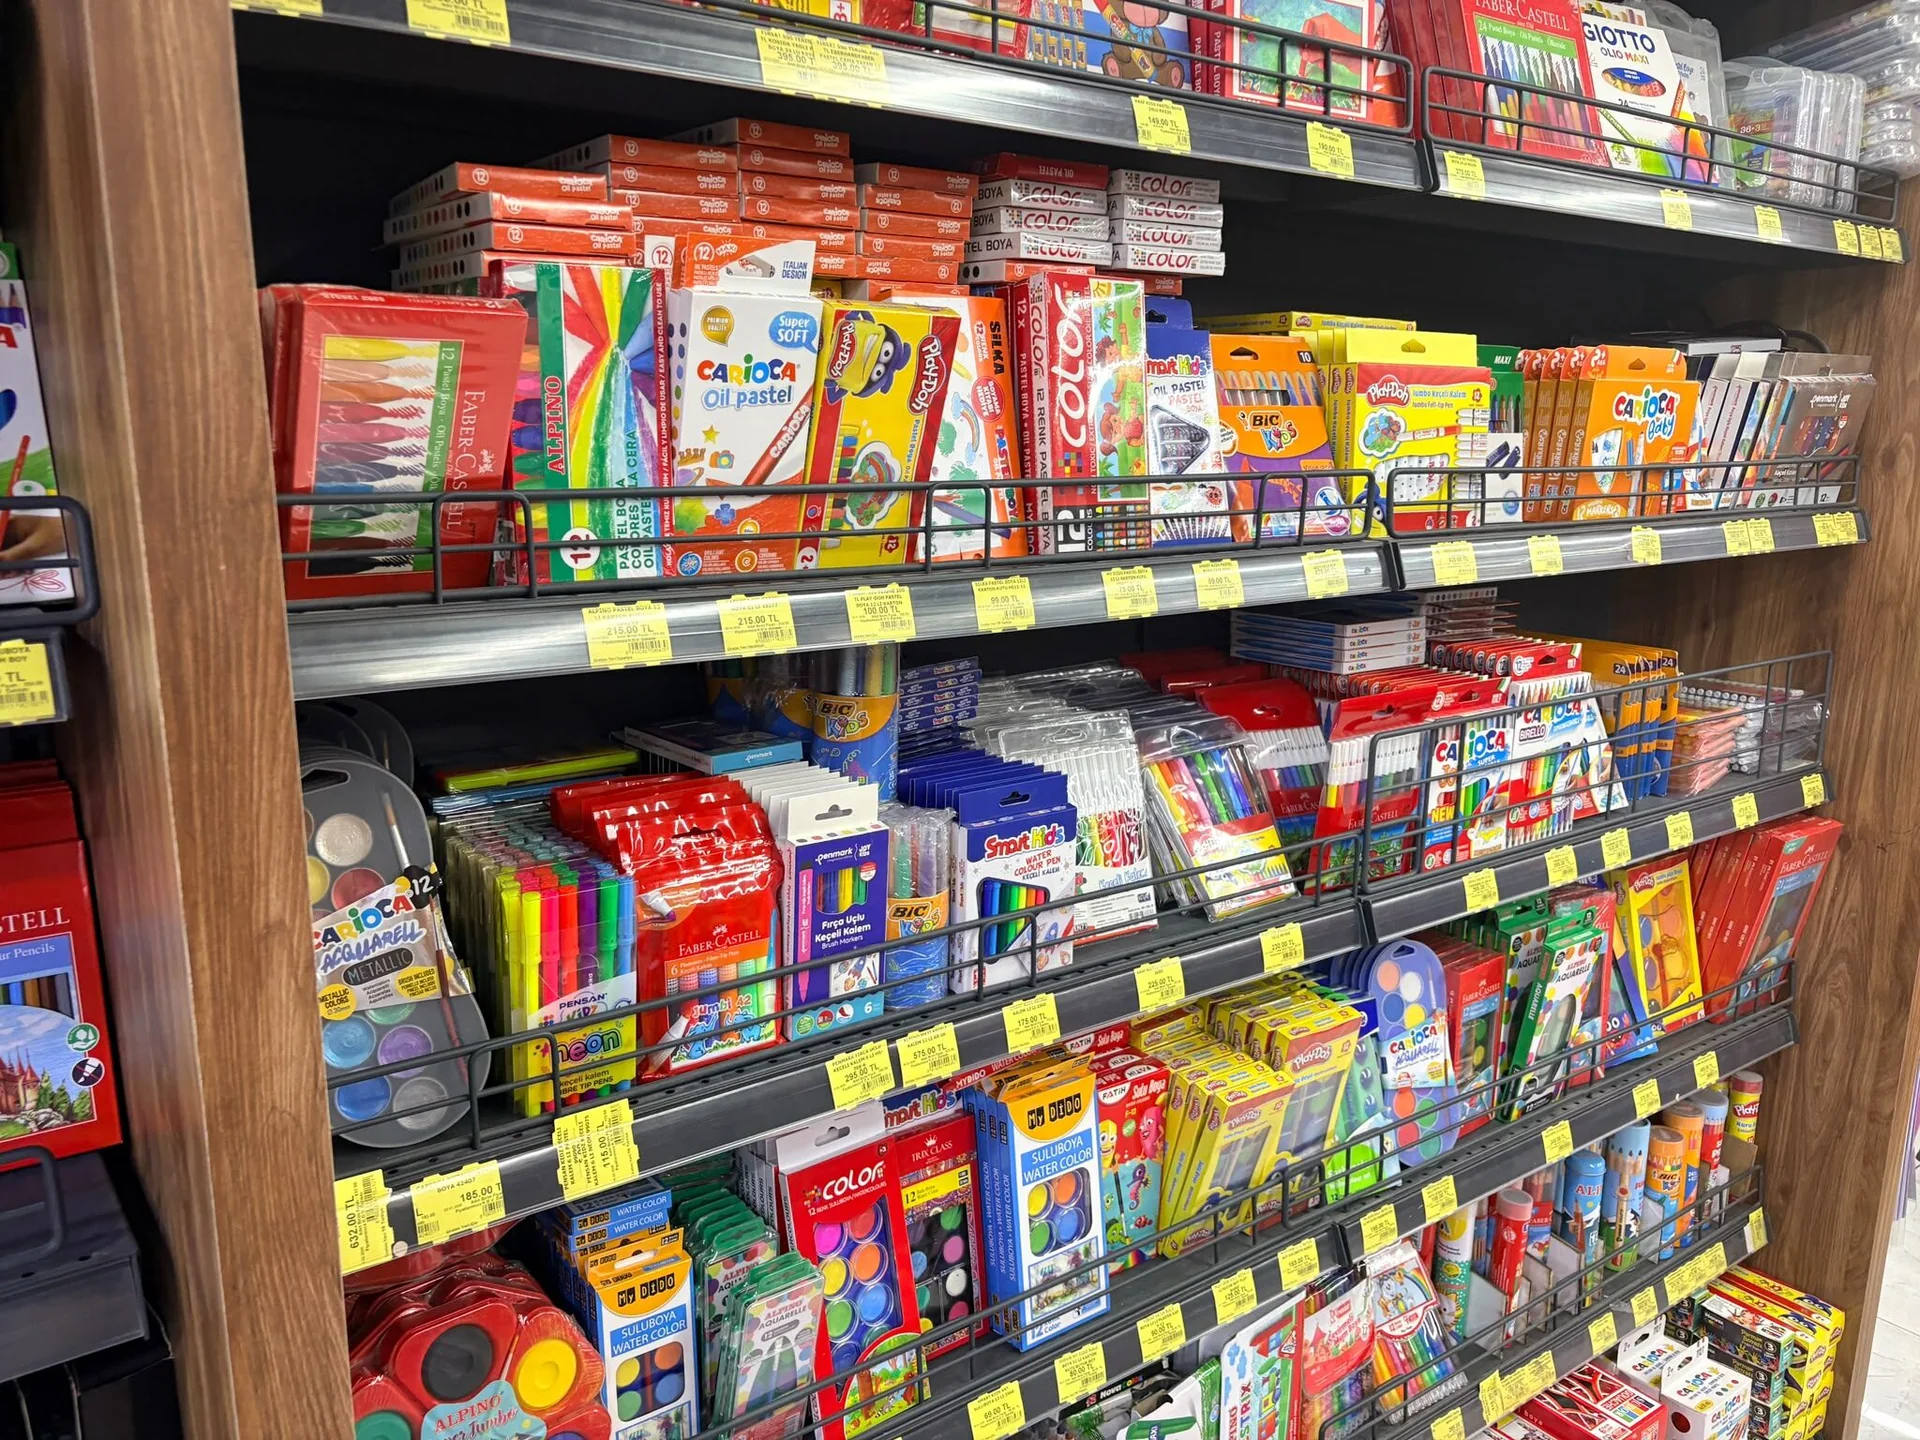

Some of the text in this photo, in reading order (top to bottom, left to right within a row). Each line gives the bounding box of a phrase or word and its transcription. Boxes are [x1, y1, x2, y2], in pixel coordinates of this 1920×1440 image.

[1583, 22, 1656, 53] GIOTTO
[777, 51, 807, 64] 395.00
[1601, 47, 1650, 65] OLIO MAXI
[1148, 116, 1179, 128] 149.00 TL
[476, 171, 487, 183] 12
[1038, 165, 1064, 177] PASTEL
[978, 184, 1003, 200] BOYA
[973, 214, 995, 228] BOYA
[696, 244, 737, 258] 12 MAXI
[986, 238, 1013, 252] BOYA
[655, 249, 671, 263] 12
[782, 260, 808, 271] ITALIAN
[781, 269, 808, 280] DESIGN
[1017, 299, 1027, 316] 12
[655, 283, 666, 373] EASY AND CLEAN USE
[778, 318, 810, 332] Super
[776, 328, 809, 344] SOFT
[442, 347, 455, 360] 12
[1299, 351, 1311, 363] 10
[1494, 354, 1511, 365] MAXI
[443, 363, 454, 389] Pastel
[658, 380, 666, 401] USAR
[1153, 380, 1206, 396] OIL PASTEL
[1449, 390, 1467, 399] Kalem
[702, 386, 792, 409] Oil pastel
[1019, 352, 1031, 447] PASTEL BOYA OIL
[543, 375, 566, 475] ALPINO
[1036, 388, 1048, 446] 12 RENK
[1647, 413, 1675, 442] Baby
[625, 430, 637, 468] CERA
[446, 390, 486, 529] FABER-CASELL
[1057, 508, 1085, 553] 12
[570, 533, 592, 565] 12
[643, 546, 654, 569] OIL
[990, 595, 1020, 605] 99.00 TL
[863, 605, 901, 615] 100.00 TL
[737, 614, 780, 627] 215.00 TL
[606, 623, 654, 636] 215.00 TL
[1615, 665, 1626, 674] 24
[1662, 657, 1674, 667] 24
[4, 671, 26, 683] TL
[1519, 724, 1547, 741] BIRELLO
[1431, 807, 1455, 823] NEW
[985, 823, 1066, 860] Smart Kids
[815, 846, 854, 866] penmark
[1025, 849, 1053, 864] WATER
[1778, 850, 1829, 875] FABER-CASTELL
[1013, 855, 1062, 877] COLOUR PEN
[1042, 865, 1060, 877] KALEM
[412, 875, 434, 895] 12
[0, 907, 70, 933] TELL
[821, 912, 866, 931] Fırça Uçlu
[815, 922, 871, 944] Keçeli Kalem
[13, 943, 56, 958] Pencils
[320, 922, 425, 972] ACQUARELL
[678, 929, 762, 957] FABER-CASTELL
[821, 934, 864, 950] Brush Markers
[346, 950, 411, 983] METALLIC
[671, 965, 678, 976] 6
[1555, 963, 1591, 984] AQUARELLE
[1147, 979, 1167, 989] 225.00
[324, 996, 350, 1008] COLORS
[559, 993, 606, 1010] PENSAN
[1461, 983, 1501, 1004] FABER-CASTELL
[1528, 982, 1543, 1021] AQUARELLE
[864, 1001, 873, 1014] 6
[1017, 1013, 1048, 1027] 175.00 TL
[557, 1028, 621, 1064] neon
[913, 1043, 948, 1060] 575.00 TL
[585, 1070, 610, 1082] kalem
[844, 1062, 880, 1082] 295.00 TL
[955, 1068, 987, 1091] MYDIDO
[580, 1076, 614, 1090] TIP PENS
[598, 1136, 610, 1168] 115.00
[911, 1140, 953, 1163] TRIX CLASS
[1031, 1138, 1083, 1165] SULUBOYA
[1023, 1148, 1093, 1185] WATER COLOR
[459, 1187, 493, 1204] 185.00
[904, 1191, 917, 1205] 12
[617, 1195, 668, 1216] WATER COLOR
[808, 1206, 817, 1216] 12
[817, 1201, 829, 1212] RENK
[344, 1194, 361, 1250] 632.00 TL
[614, 1212, 664, 1233] WATER COLOR
[758, 1304, 808, 1331] AQUARELLE
[764, 1298, 804, 1321] ALPINO
[621, 1311, 677, 1339] SULUBOYA
[1045, 1319, 1062, 1336] Color
[1151, 1323, 1173, 1337] 90.00 TL
[612, 1317, 687, 1356] WATER COLOR
[1085, 1363, 1094, 1373] TL
[1100, 1383, 1122, 1399] Nova
[434, 1394, 502, 1433] ALPINO
[983, 1404, 1011, 1419] 69.00 TL
